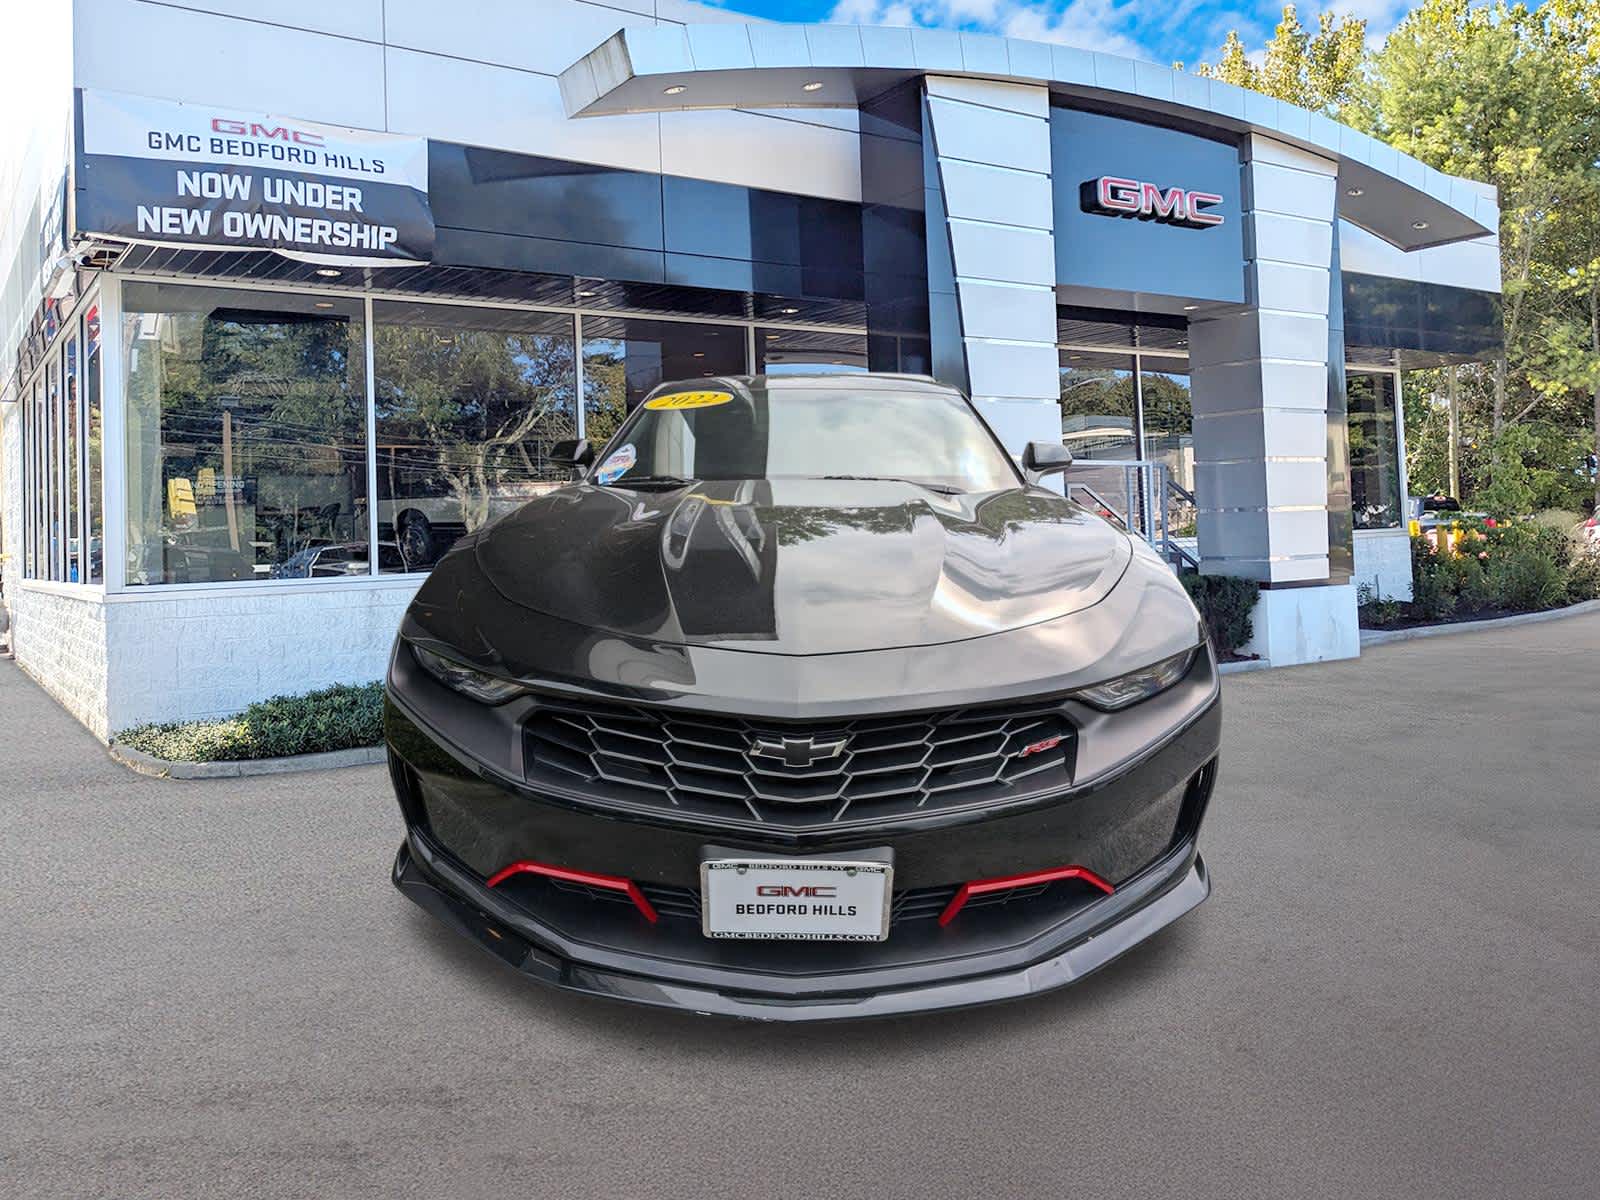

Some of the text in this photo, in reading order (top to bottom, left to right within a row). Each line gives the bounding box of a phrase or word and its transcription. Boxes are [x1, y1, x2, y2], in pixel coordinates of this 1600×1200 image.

[211, 118, 325, 148] GMC
[147, 131, 385, 174] GMC BEDFORD HILLS
[177, 170, 363, 213] NOW UNDER
[1096, 175, 1224, 225] GMC
[137, 205, 398, 250] NEW OWNERSHIP
[756, 885, 837, 898] GMC
[736, 904, 857, 916] BEDFORD HILLS
[712, 932, 880, 942] GMCBEDFORDHILLS.COM
